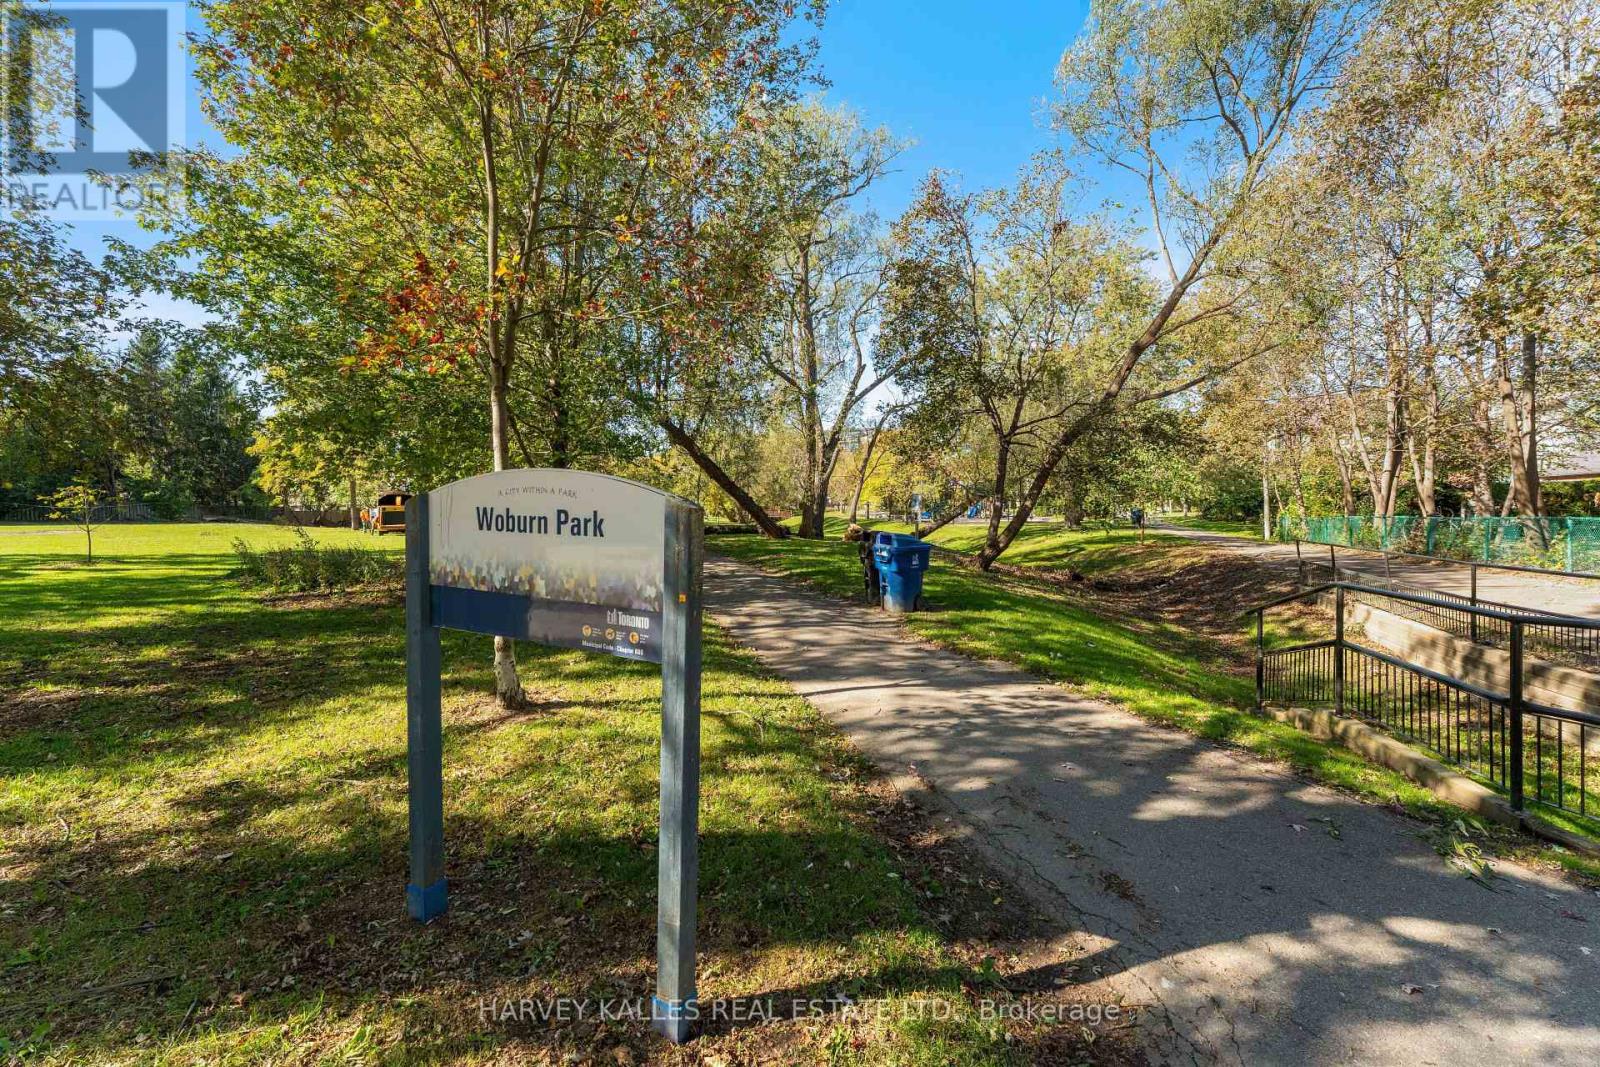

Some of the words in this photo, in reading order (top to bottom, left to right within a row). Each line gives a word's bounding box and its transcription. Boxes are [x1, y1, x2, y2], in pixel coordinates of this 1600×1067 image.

[476, 506, 548, 534] Woburn
[556, 508, 604, 538] Park
[618, 612, 649, 629] TORONTO
